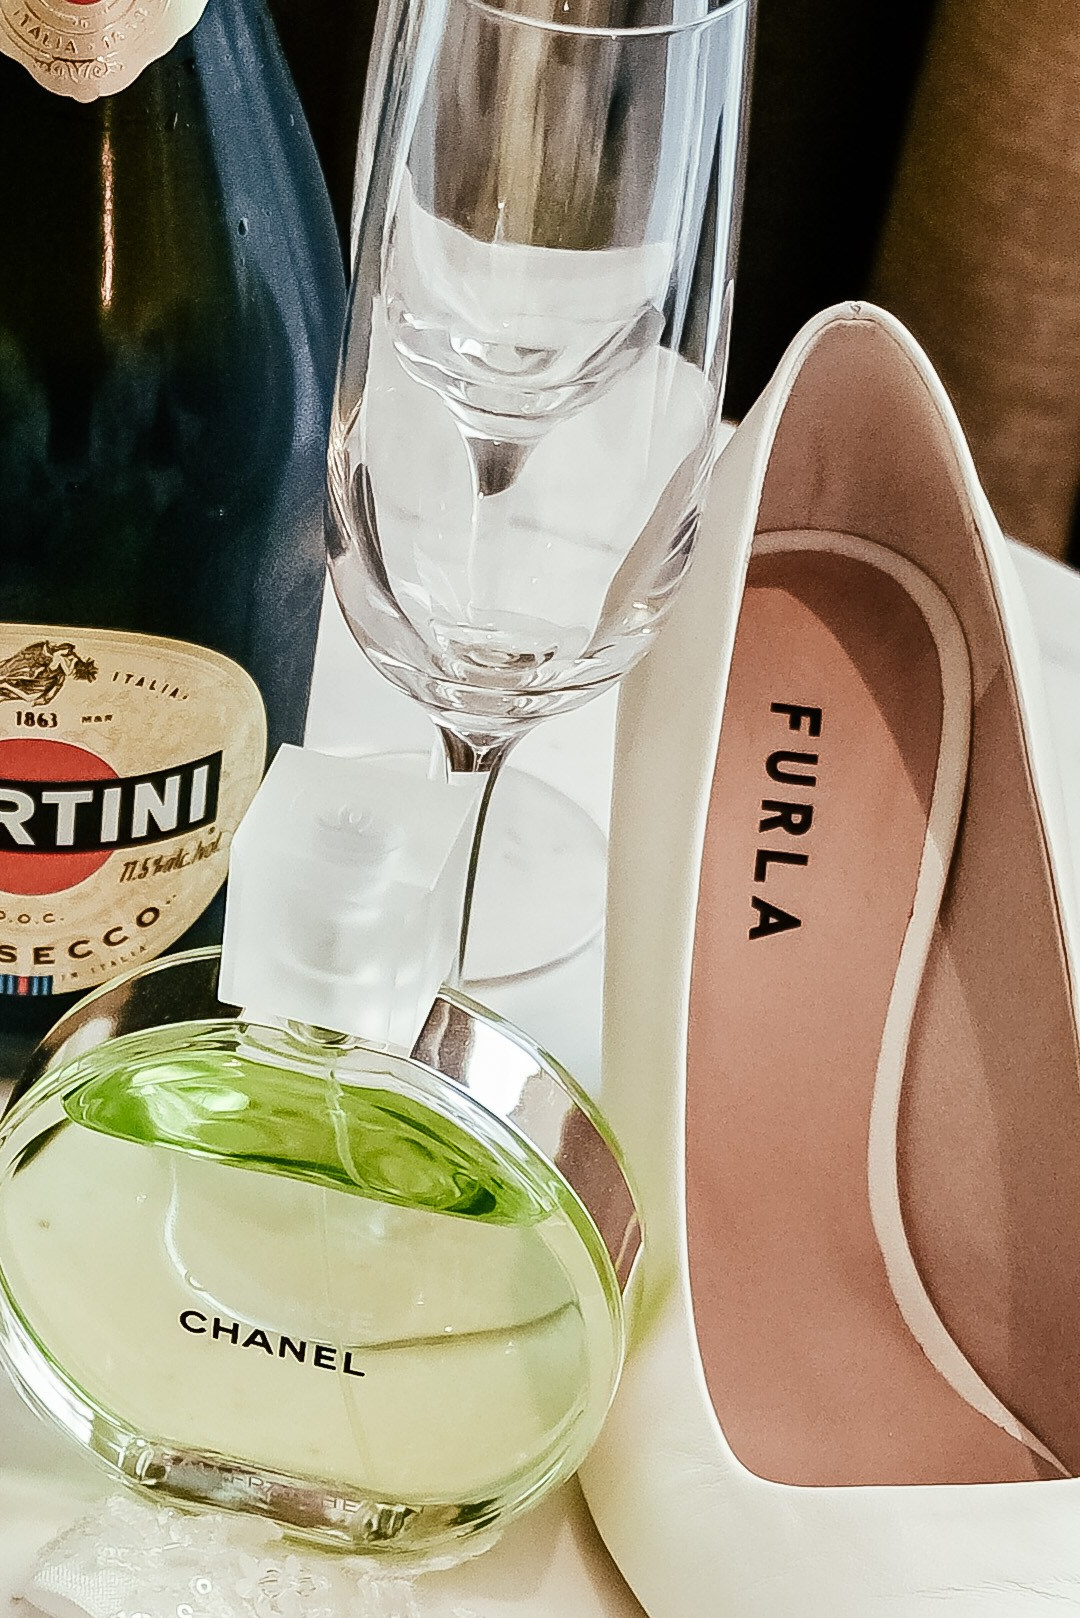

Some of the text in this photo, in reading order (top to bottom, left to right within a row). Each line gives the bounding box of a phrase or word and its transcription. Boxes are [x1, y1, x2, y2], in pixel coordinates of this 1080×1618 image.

[112, 671, 180, 699] ITALIA
[15, 710, 59, 729] 1863
[748, 702, 823, 941] FURLA
[179, 1310, 366, 1377] CHANEL
